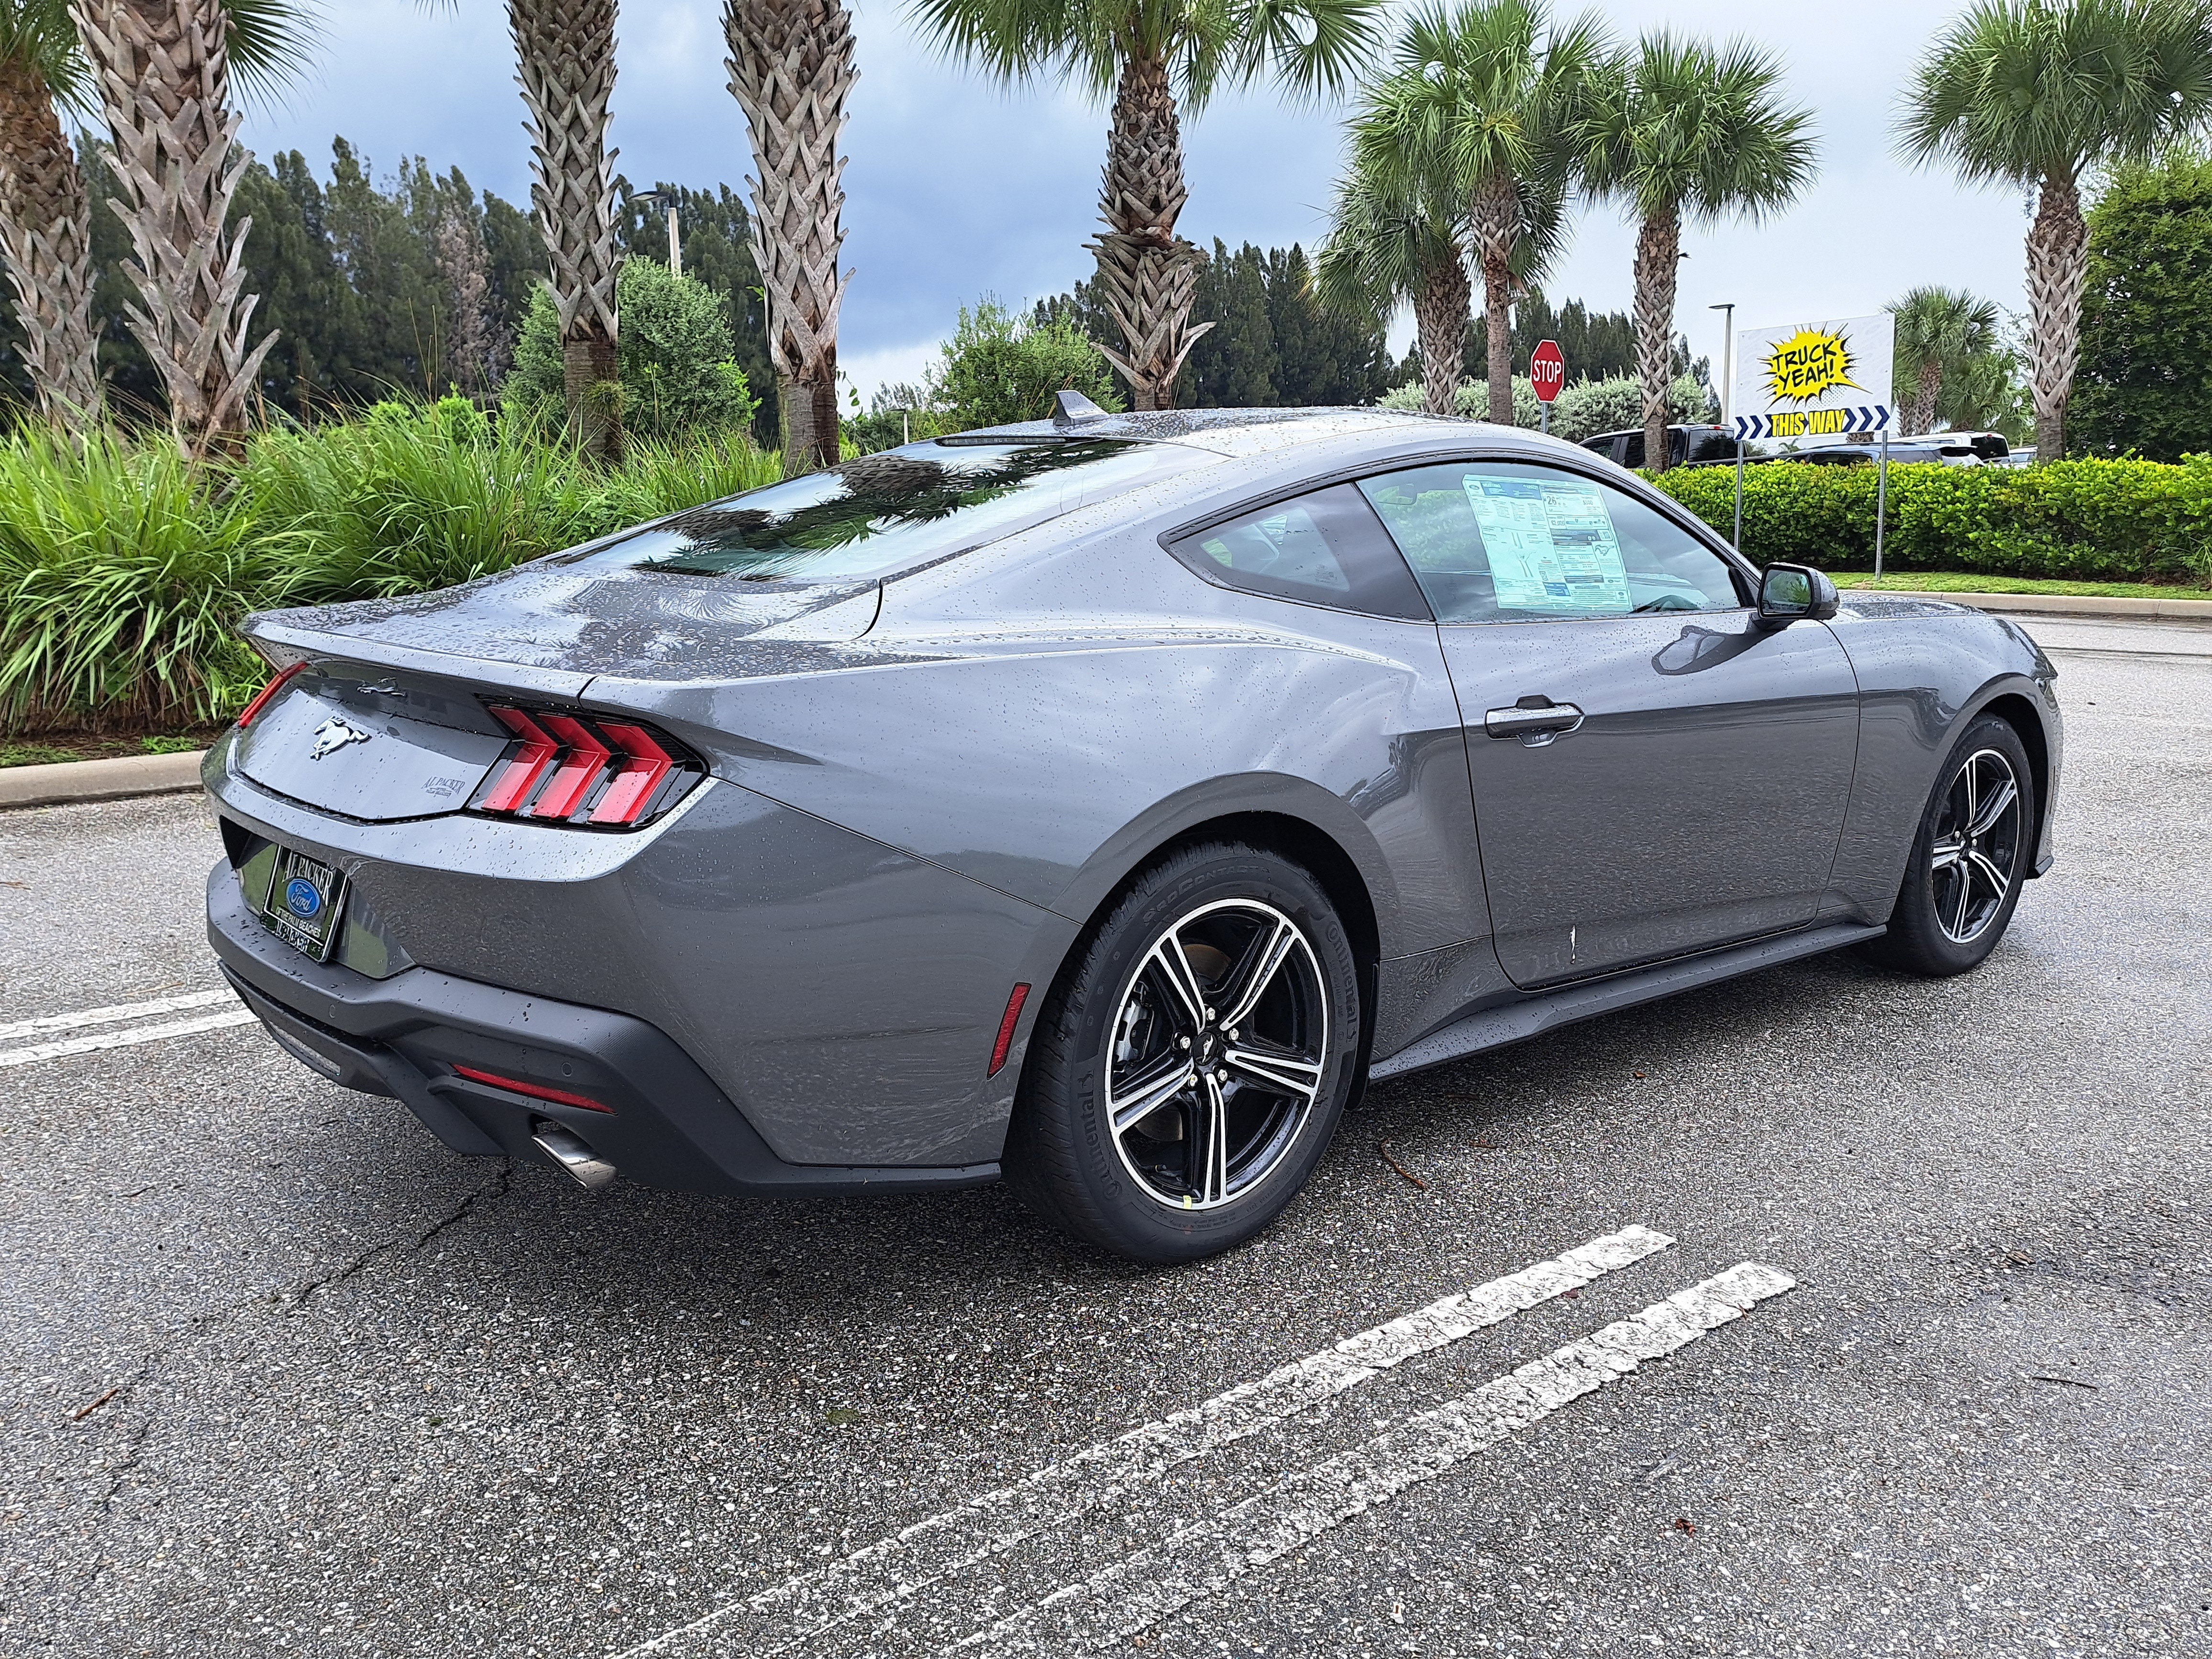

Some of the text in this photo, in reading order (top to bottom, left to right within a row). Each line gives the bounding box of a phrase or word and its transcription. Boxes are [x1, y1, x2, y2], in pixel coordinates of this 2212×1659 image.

[1772, 340, 1837, 372] TRUCK
[1533, 359, 1561, 383] STOP
[1778, 358, 1835, 391] YEAH!
[1771, 409, 1846, 437] THIS WAY
[281, 852, 333, 907] AL PACKER
[291, 884, 313, 911] Ford
[299, 919, 321, 938] BEACHES
